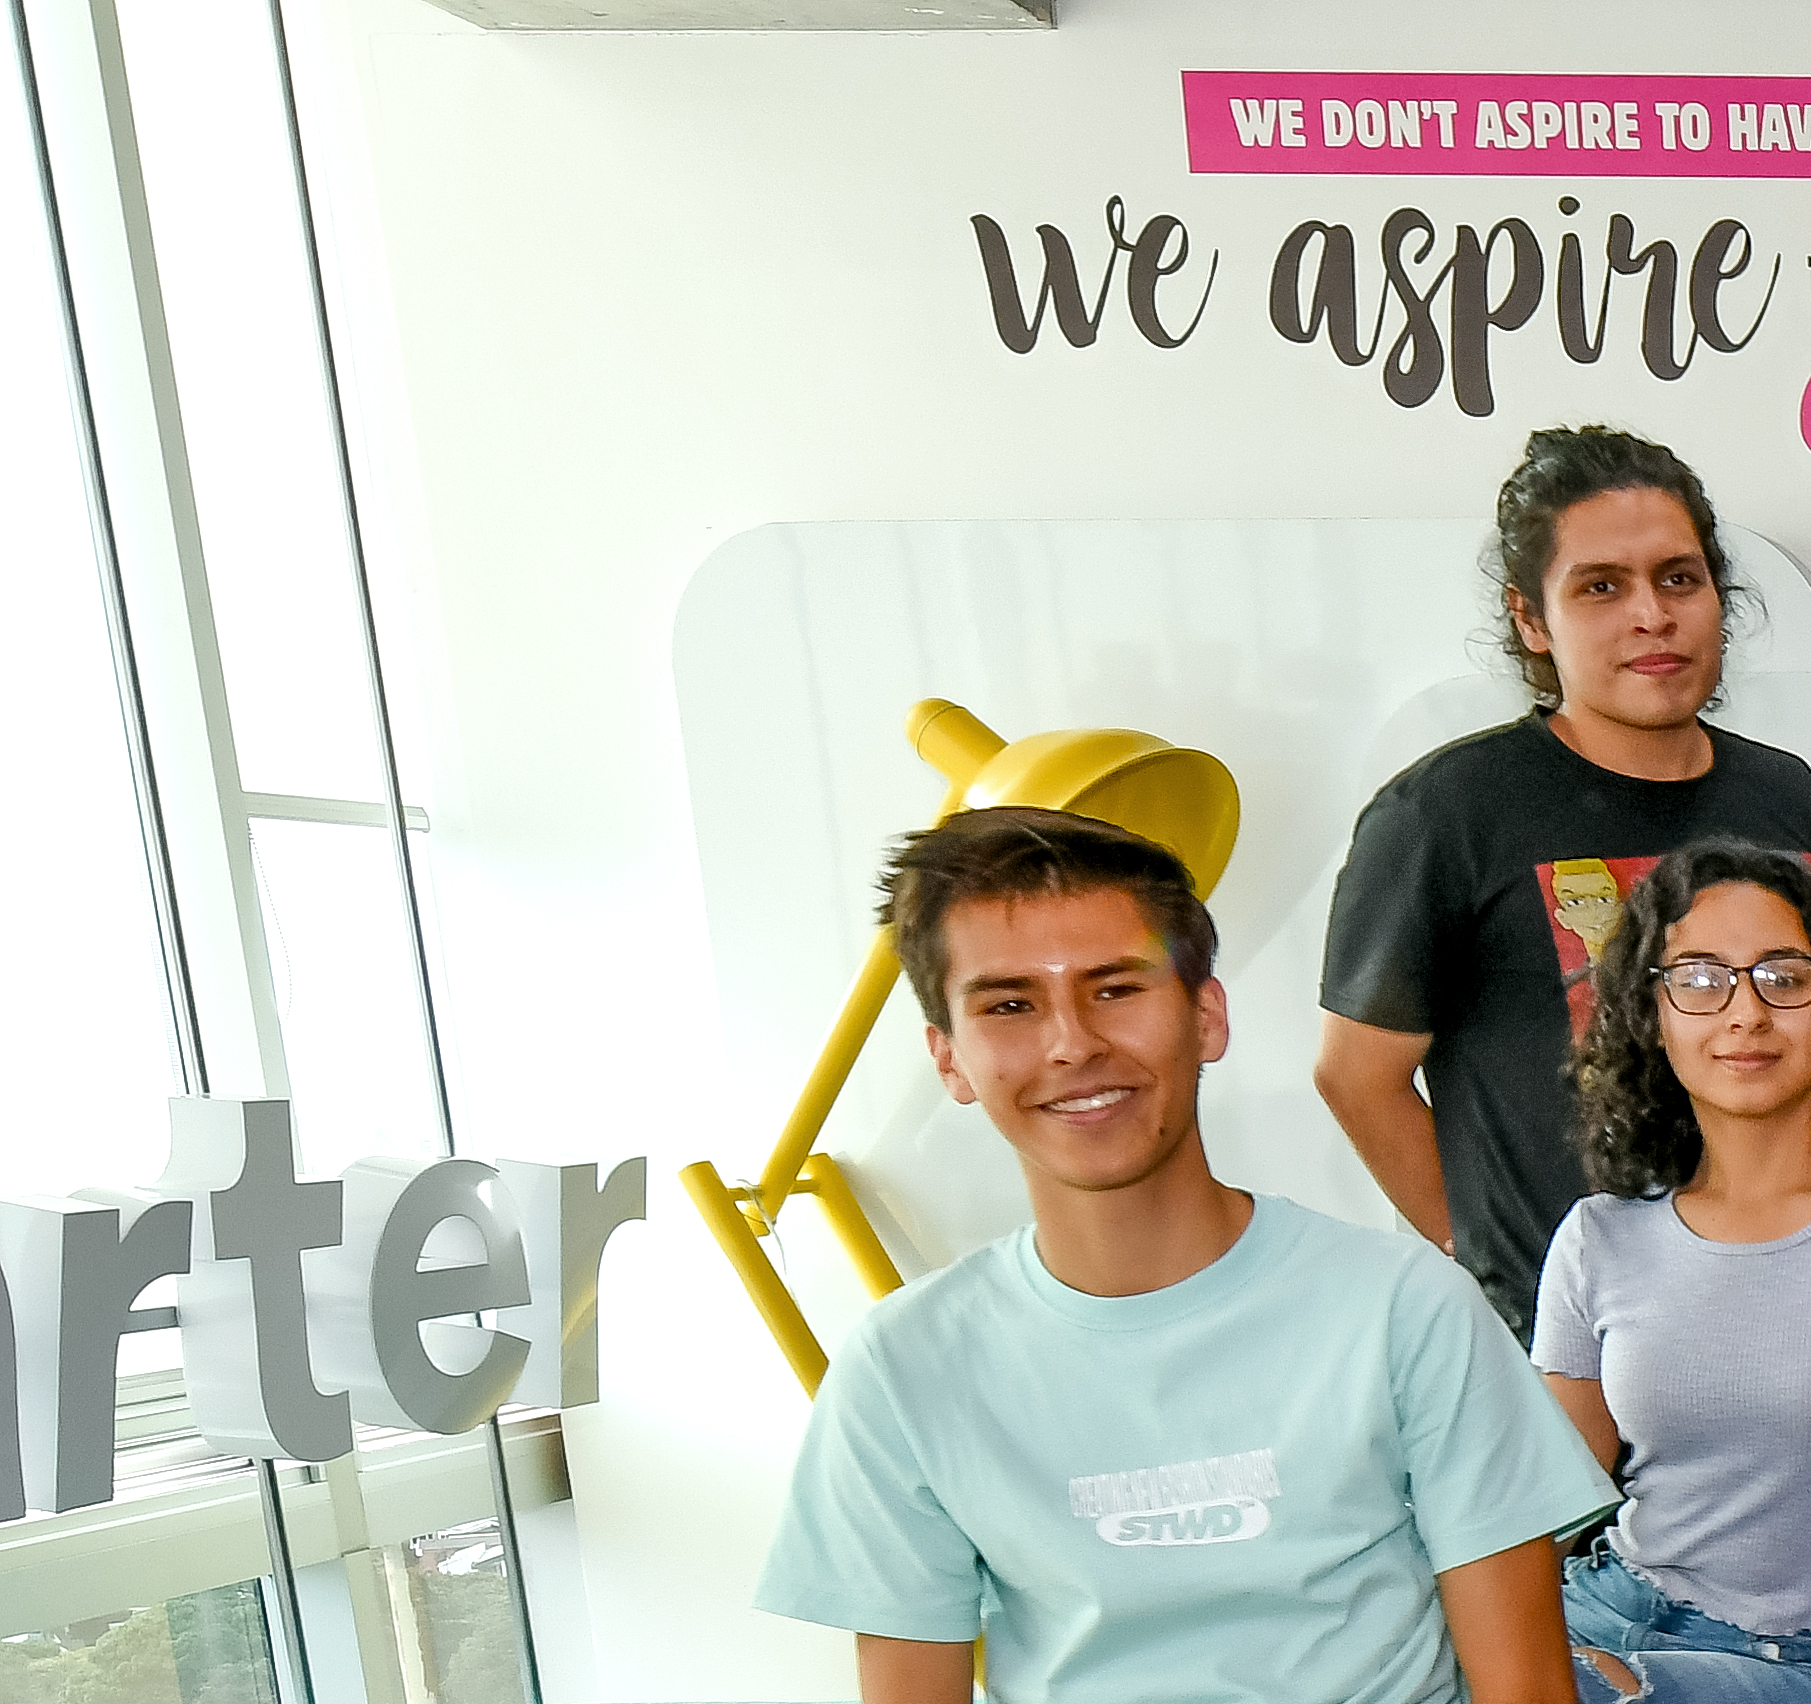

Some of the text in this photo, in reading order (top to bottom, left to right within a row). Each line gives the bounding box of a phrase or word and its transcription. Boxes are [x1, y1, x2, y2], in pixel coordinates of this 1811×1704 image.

[1229, 98, 1307, 149] WE
[1321, 99, 1459, 150] DON'T
[1474, 101, 1642, 151] ASPIRE
[1655, 102, 1711, 152] TO
[971, 194, 1782, 417] we aspire
[1115, 1504, 1243, 1541] STWD
